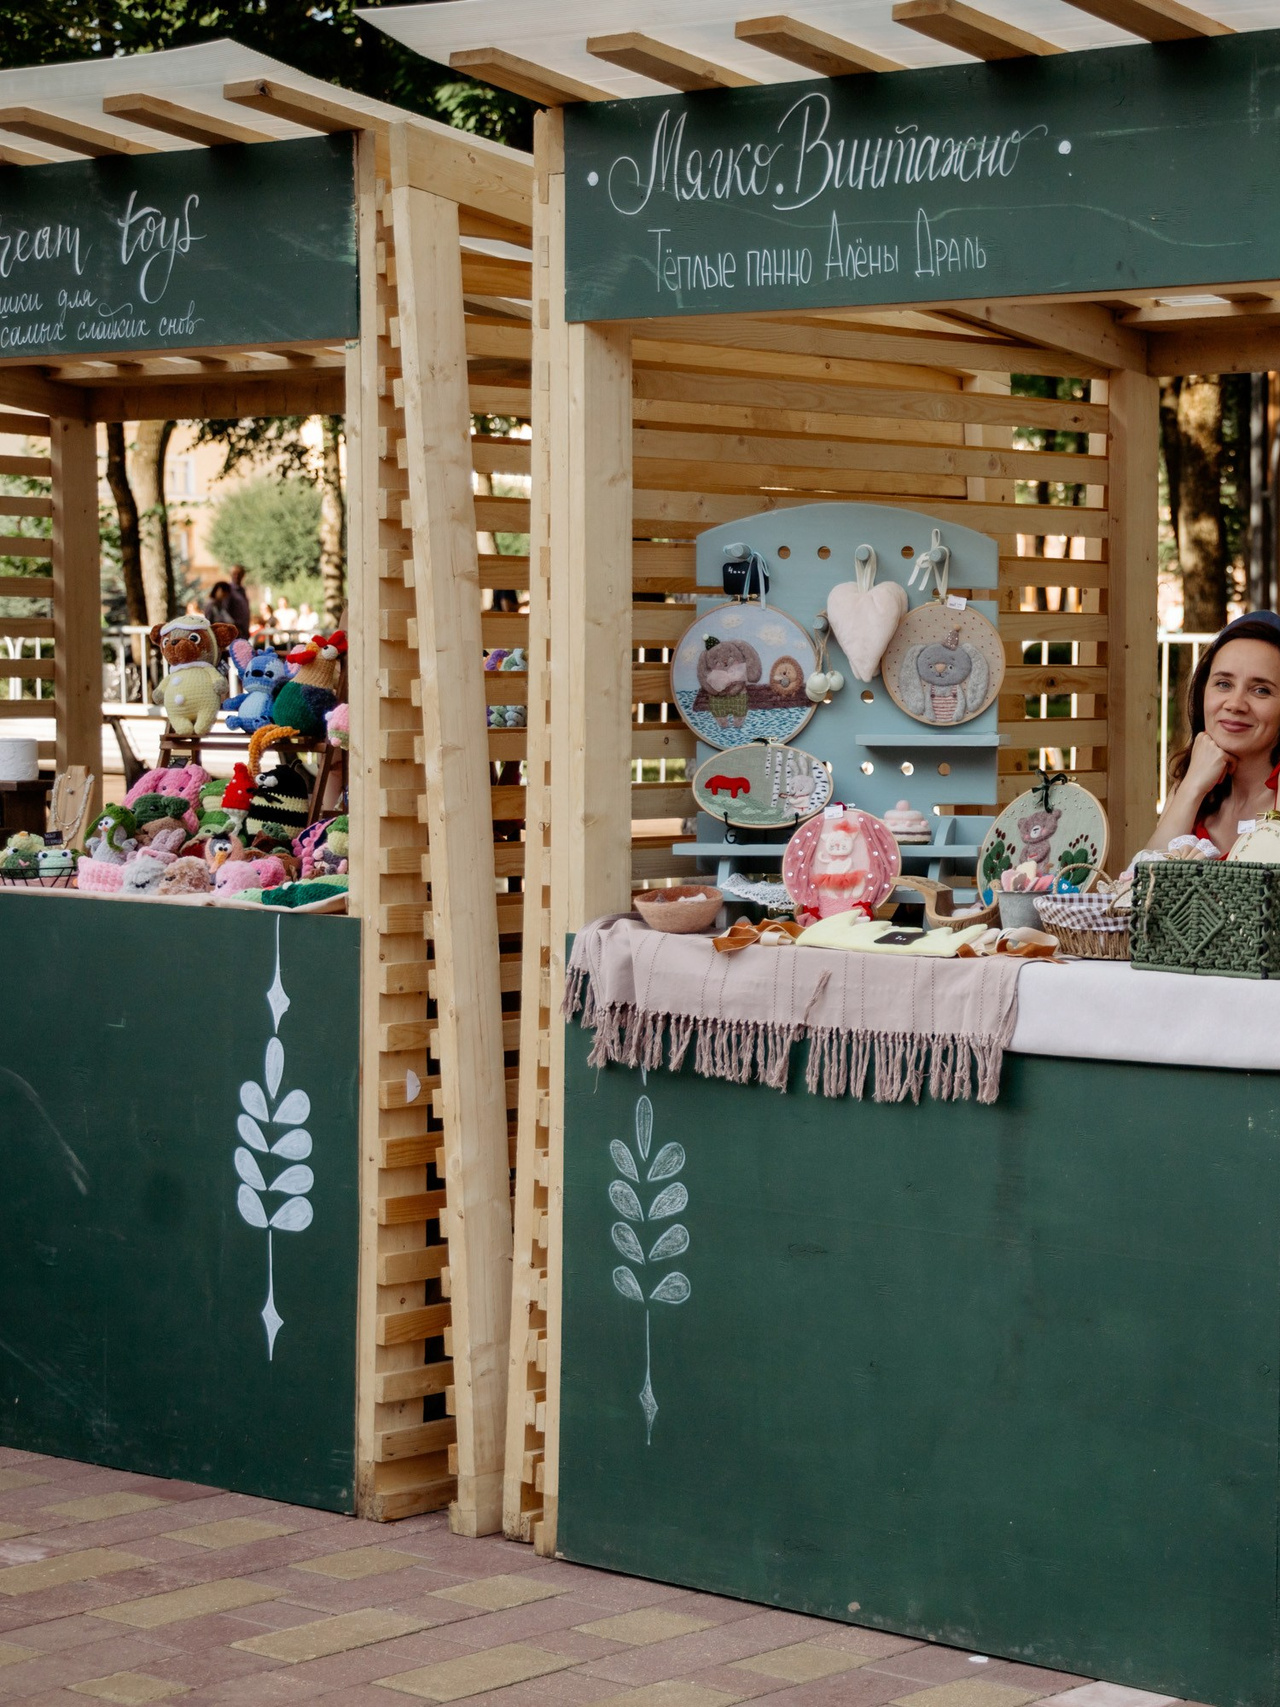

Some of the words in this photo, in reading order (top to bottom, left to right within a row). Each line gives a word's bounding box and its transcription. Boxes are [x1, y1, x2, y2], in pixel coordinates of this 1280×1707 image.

[117, 189, 208, 304] toys
[647, 228, 737, 293] Тёплые
[826, 209, 900, 279] Алёны
[0, 322, 67, 348] самых
[158, 299, 206, 337] снов
[57, 289, 99, 325] для
